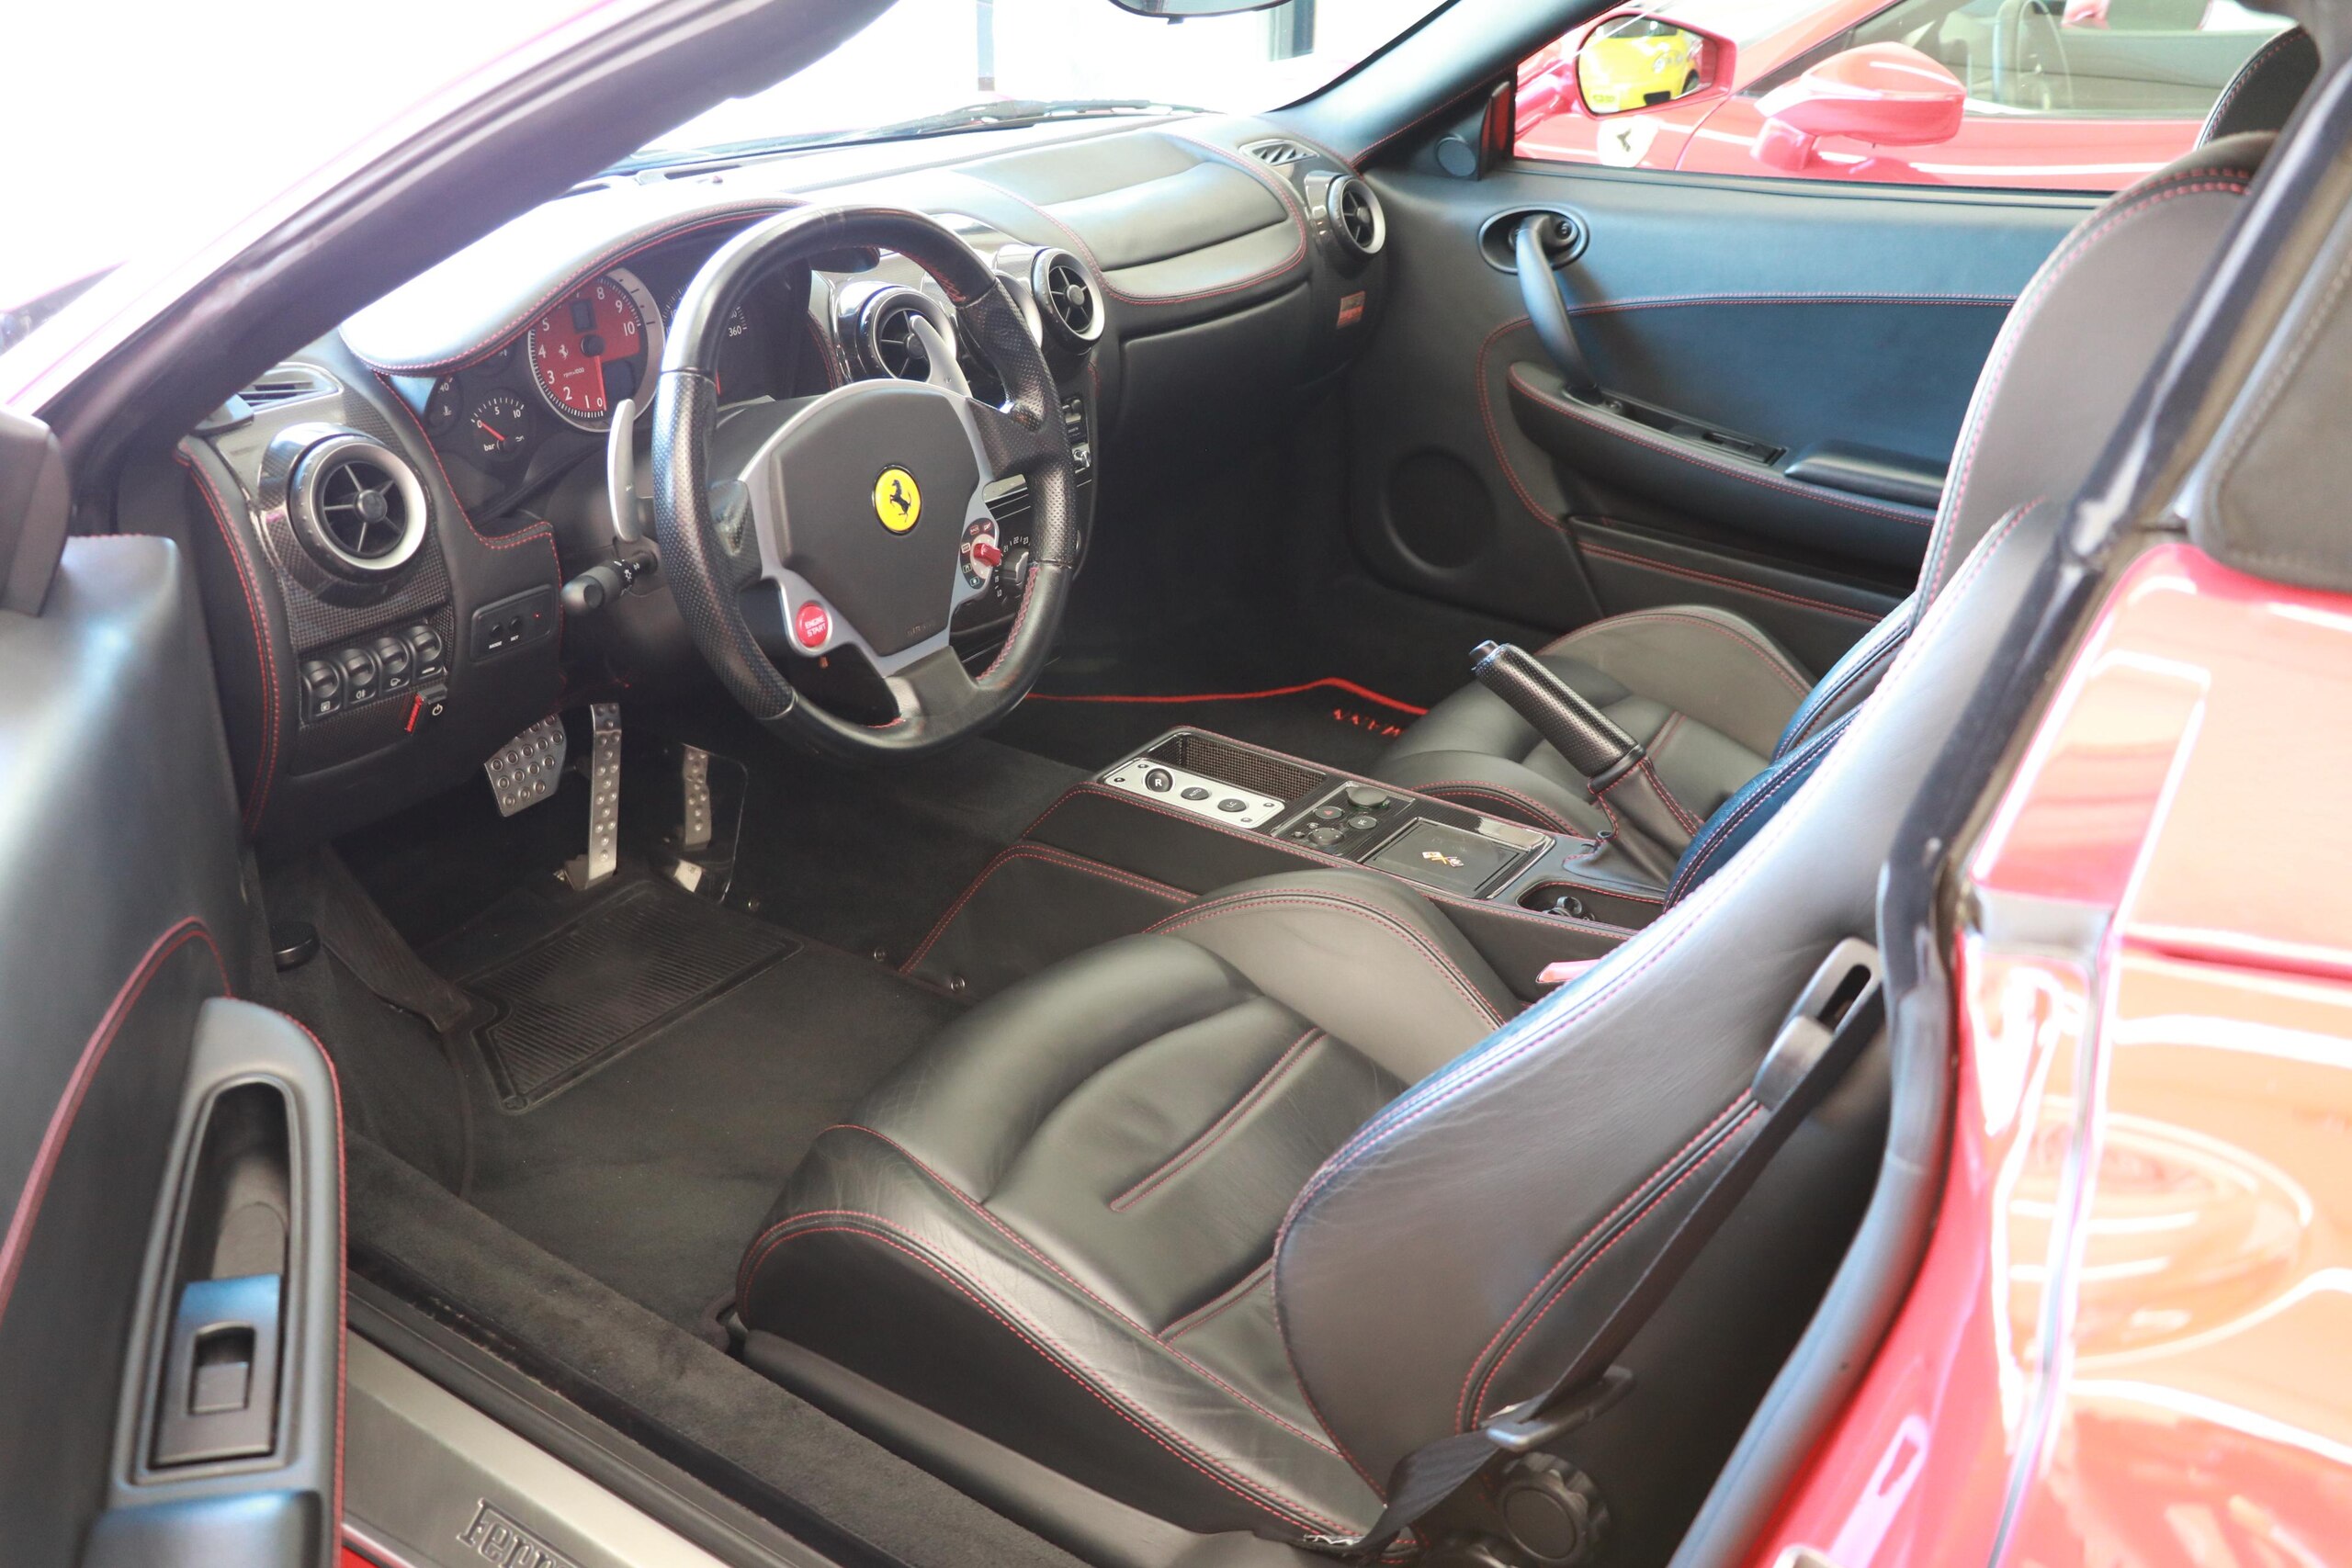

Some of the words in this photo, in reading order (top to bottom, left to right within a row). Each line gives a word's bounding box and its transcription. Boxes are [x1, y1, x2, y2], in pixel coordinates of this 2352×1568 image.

[596, 286, 605, 300] 8
[616, 299, 623, 313] 9
[542, 318, 549, 332] 5
[623, 321, 636, 336] 10
[728, 325, 742, 337] 360
[538, 344, 546, 358] 4
[547, 369, 555, 384] 3
[563, 386, 572, 400] 2
[584, 395, 590, 409] 1
[596, 397, 603, 407] 0
[495, 406, 501, 415] 5
[514, 409, 522, 419] 10
[477, 420, 482, 428] 0
[483, 443, 495, 451] bar
[804, 615, 824, 629] ENGINE
[807, 622, 826, 637] START
[1154, 778, 1163, 787] R
[456, 1497, 584, 1568] Ferr
